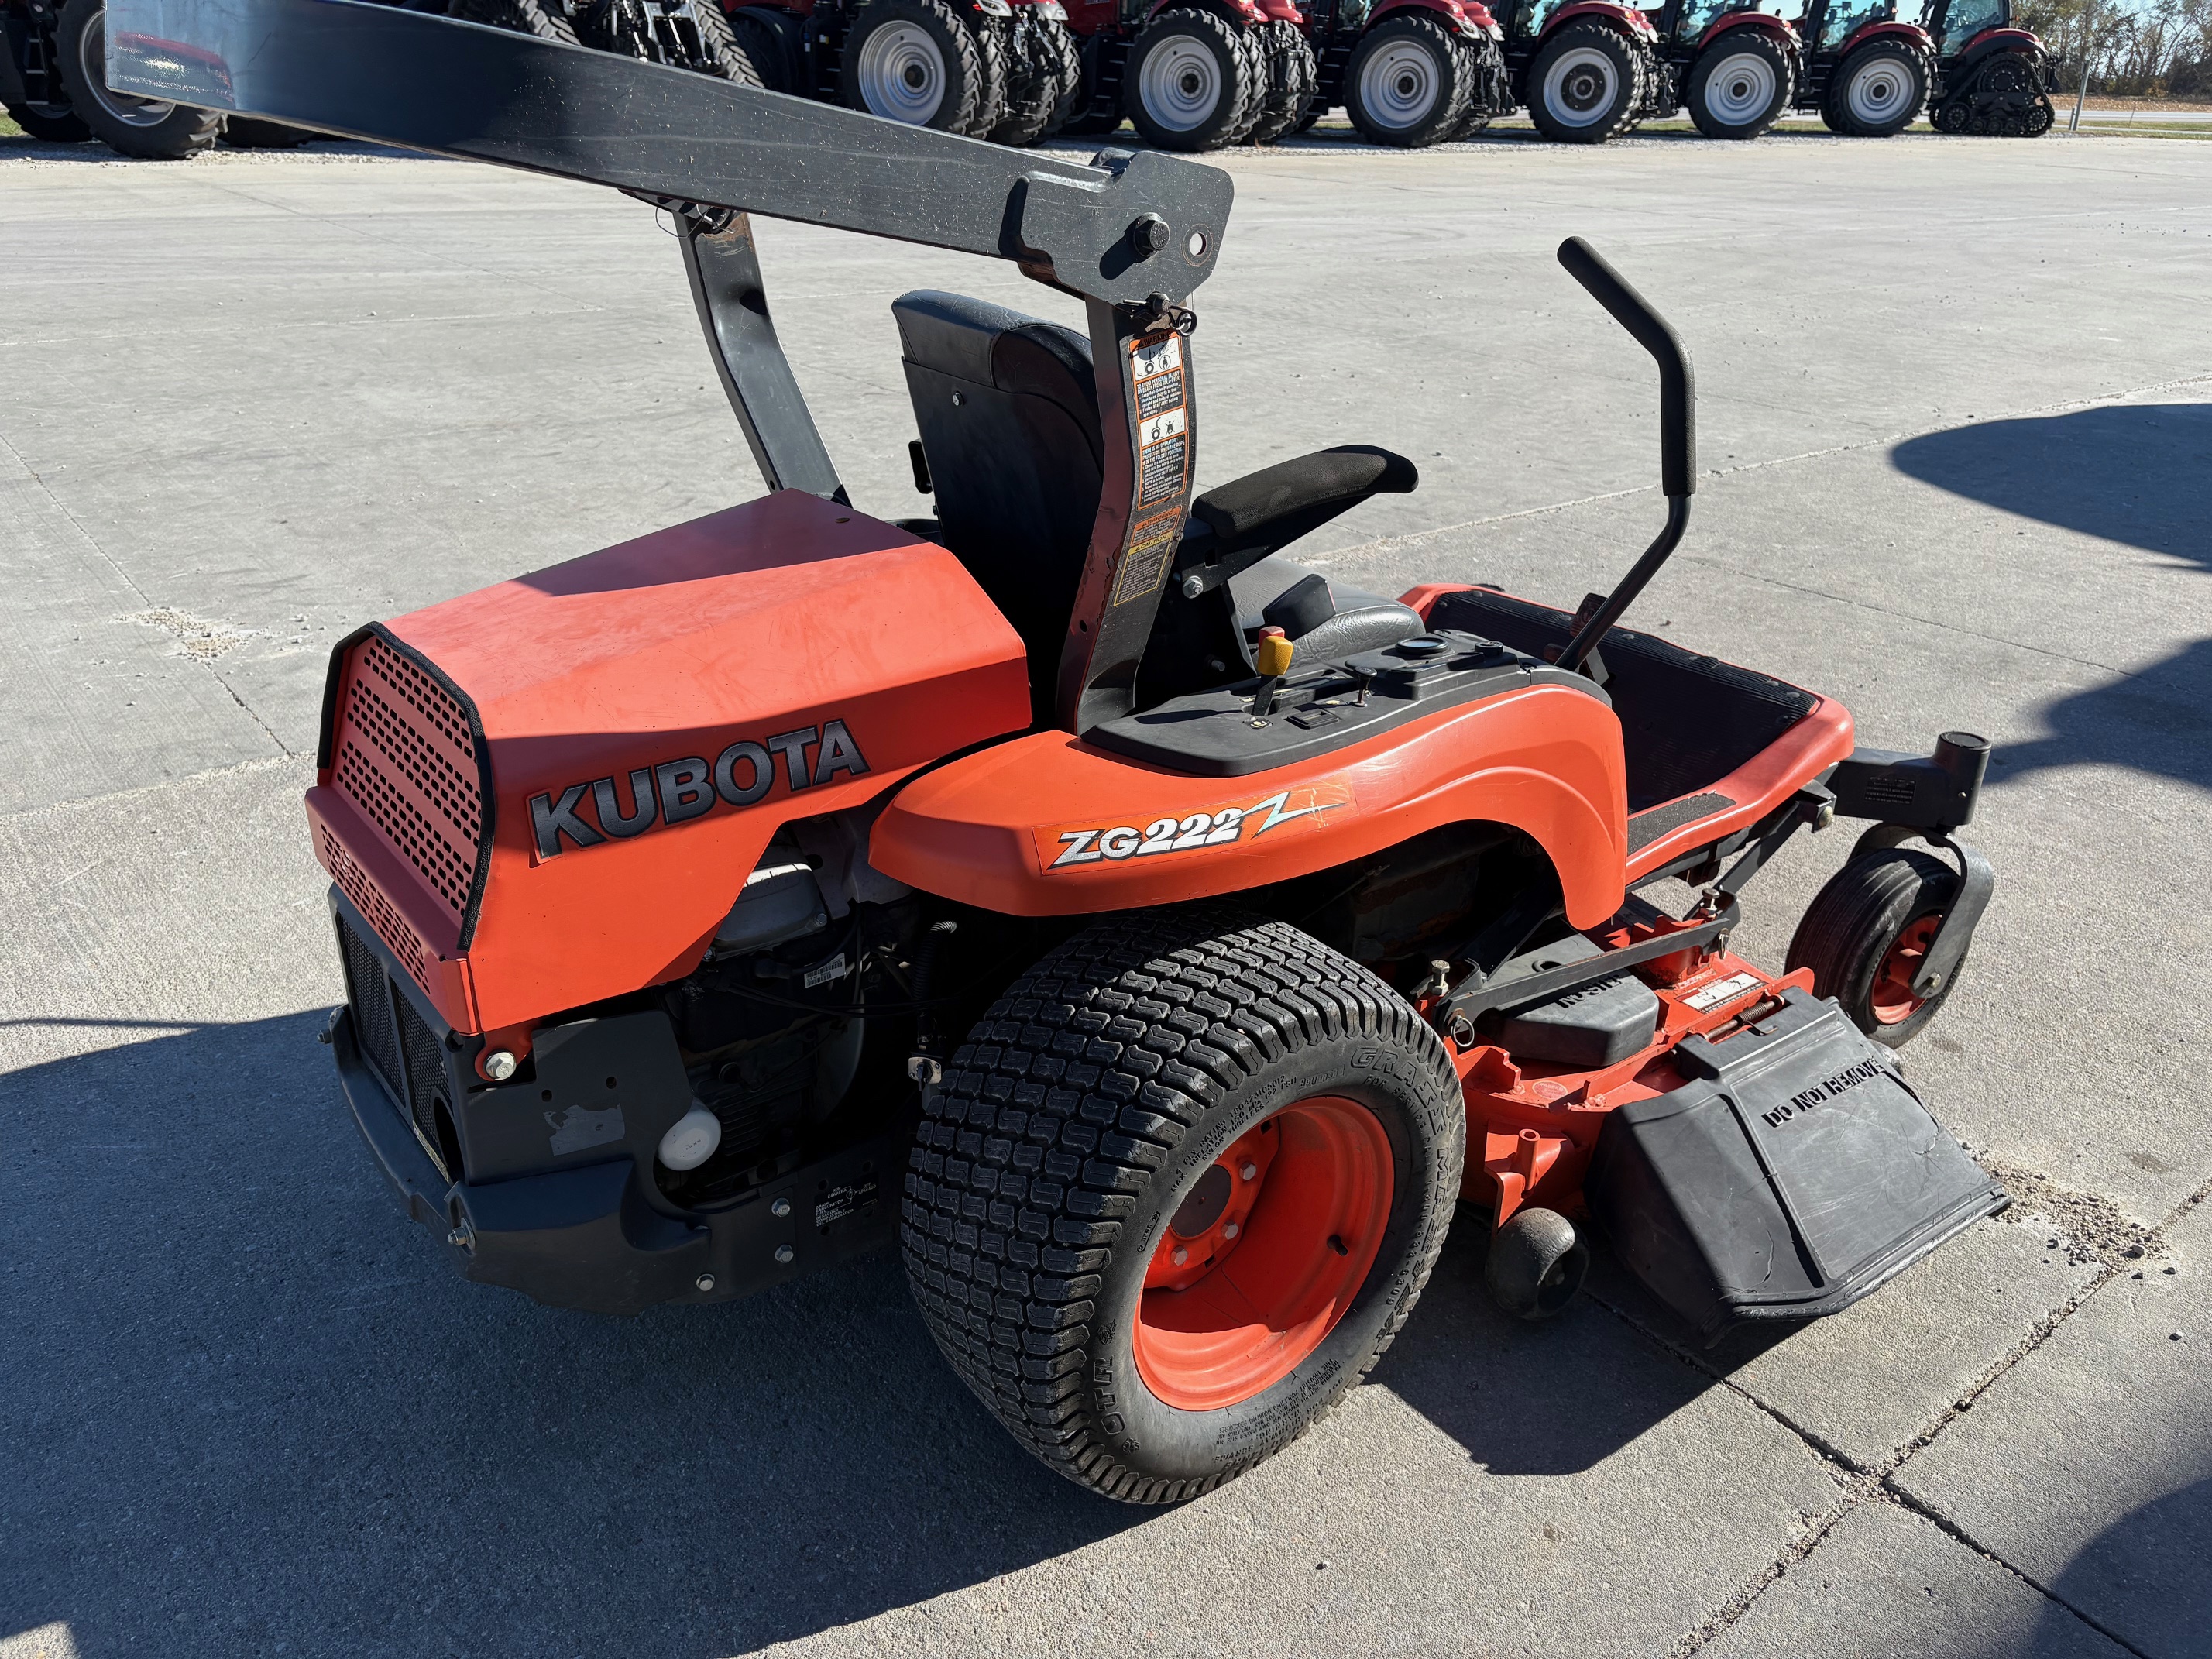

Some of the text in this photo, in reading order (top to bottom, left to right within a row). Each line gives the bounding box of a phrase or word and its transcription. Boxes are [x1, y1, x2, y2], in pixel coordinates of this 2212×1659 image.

[1141, 535, 1166, 548] CAUTION
[529, 719, 871, 860] KUBOTA
[1048, 807, 1245, 869] ZG222
[1761, 1056, 1886, 1128] DO NOT REMOVE
